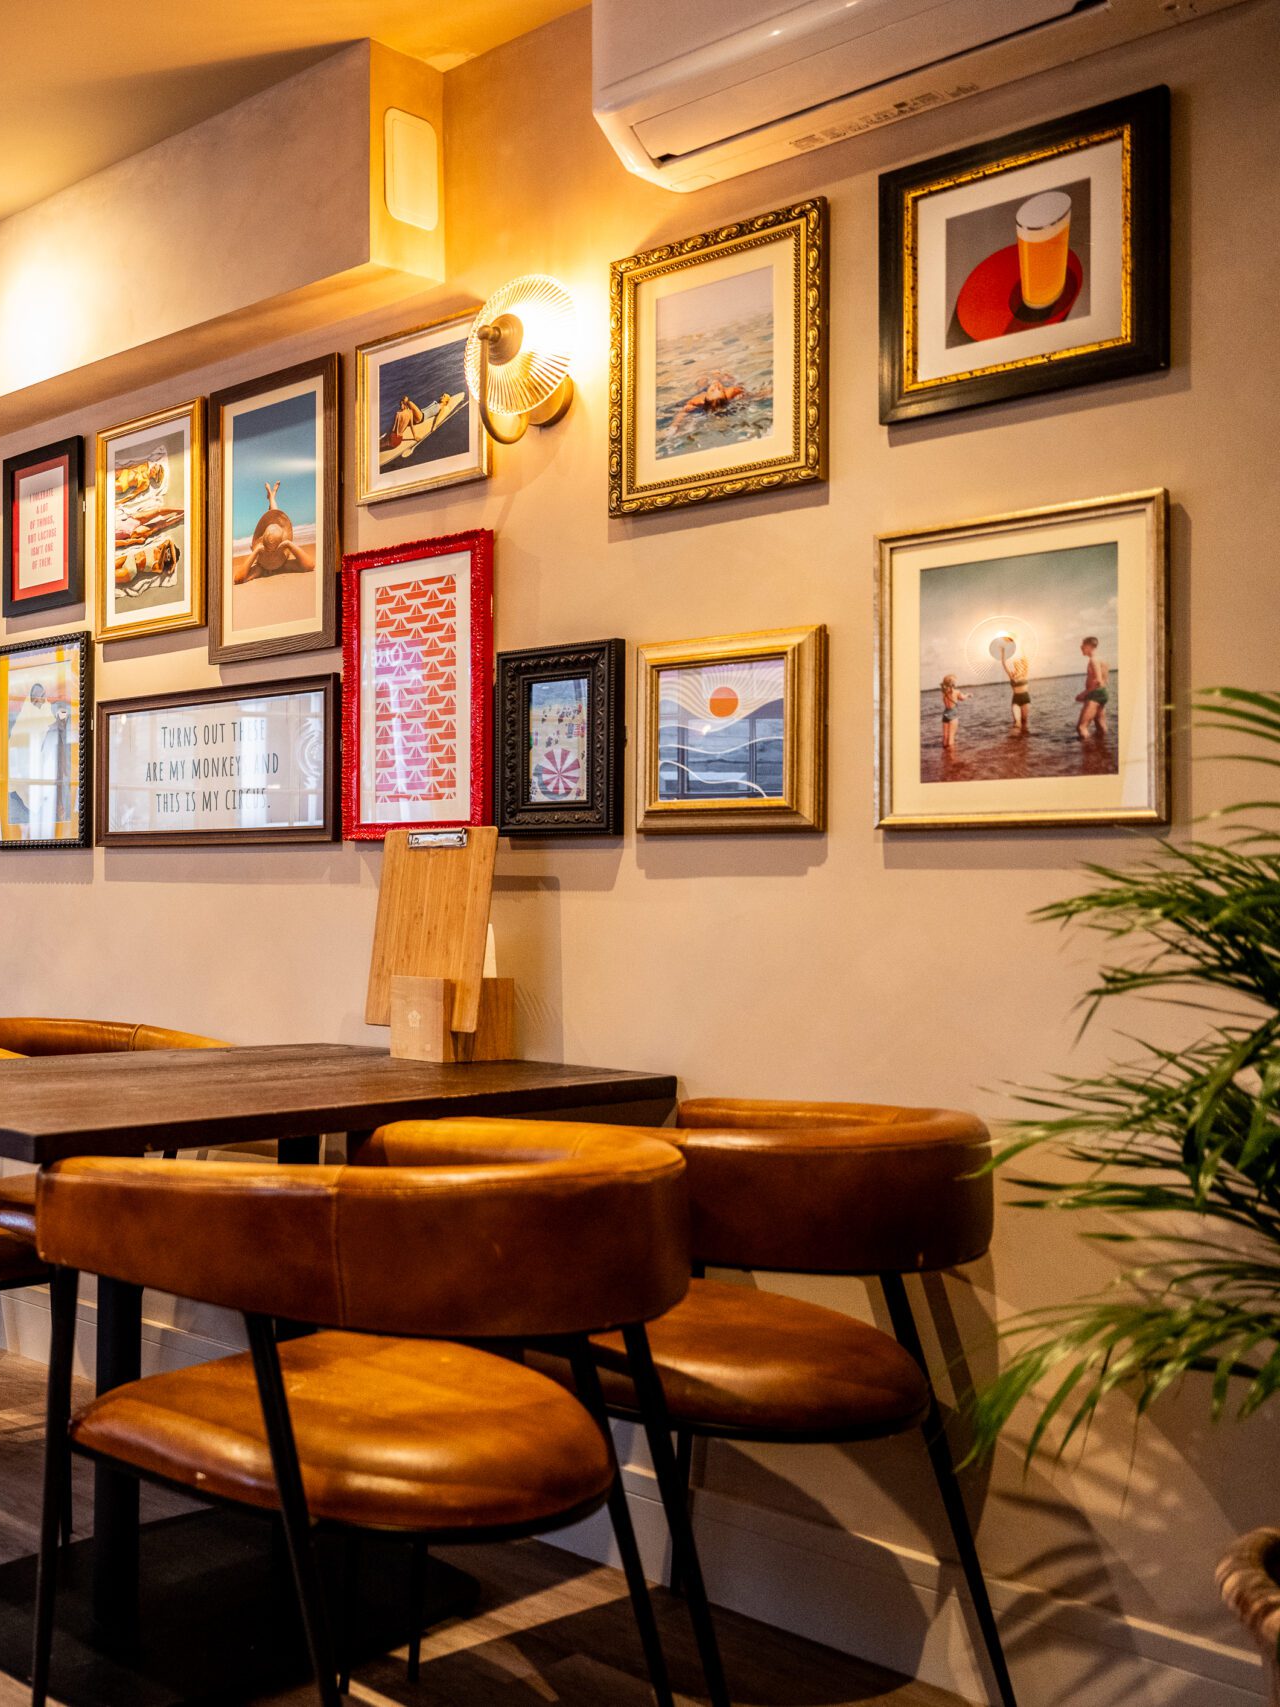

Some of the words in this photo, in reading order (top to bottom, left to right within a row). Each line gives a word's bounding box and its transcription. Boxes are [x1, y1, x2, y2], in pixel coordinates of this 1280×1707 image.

[40, 503, 49, 513] LOT
[29, 520, 36, 530] OF
[38, 528, 57, 541] LACTOSE
[161, 725, 198, 749] TURNS
[203, 723, 226, 745] OUT
[231, 719, 265, 743] THSE
[145, 762, 164, 782] ARE
[169, 759, 185, 781] MY
[191, 755, 248, 780] MONKEY
[254, 752, 279, 775] AND
[156, 792, 180, 813] THIS
[185, 791, 196, 812] IS
[202, 790, 219, 812] MY
[225, 787, 271, 811] CIRCUS.
